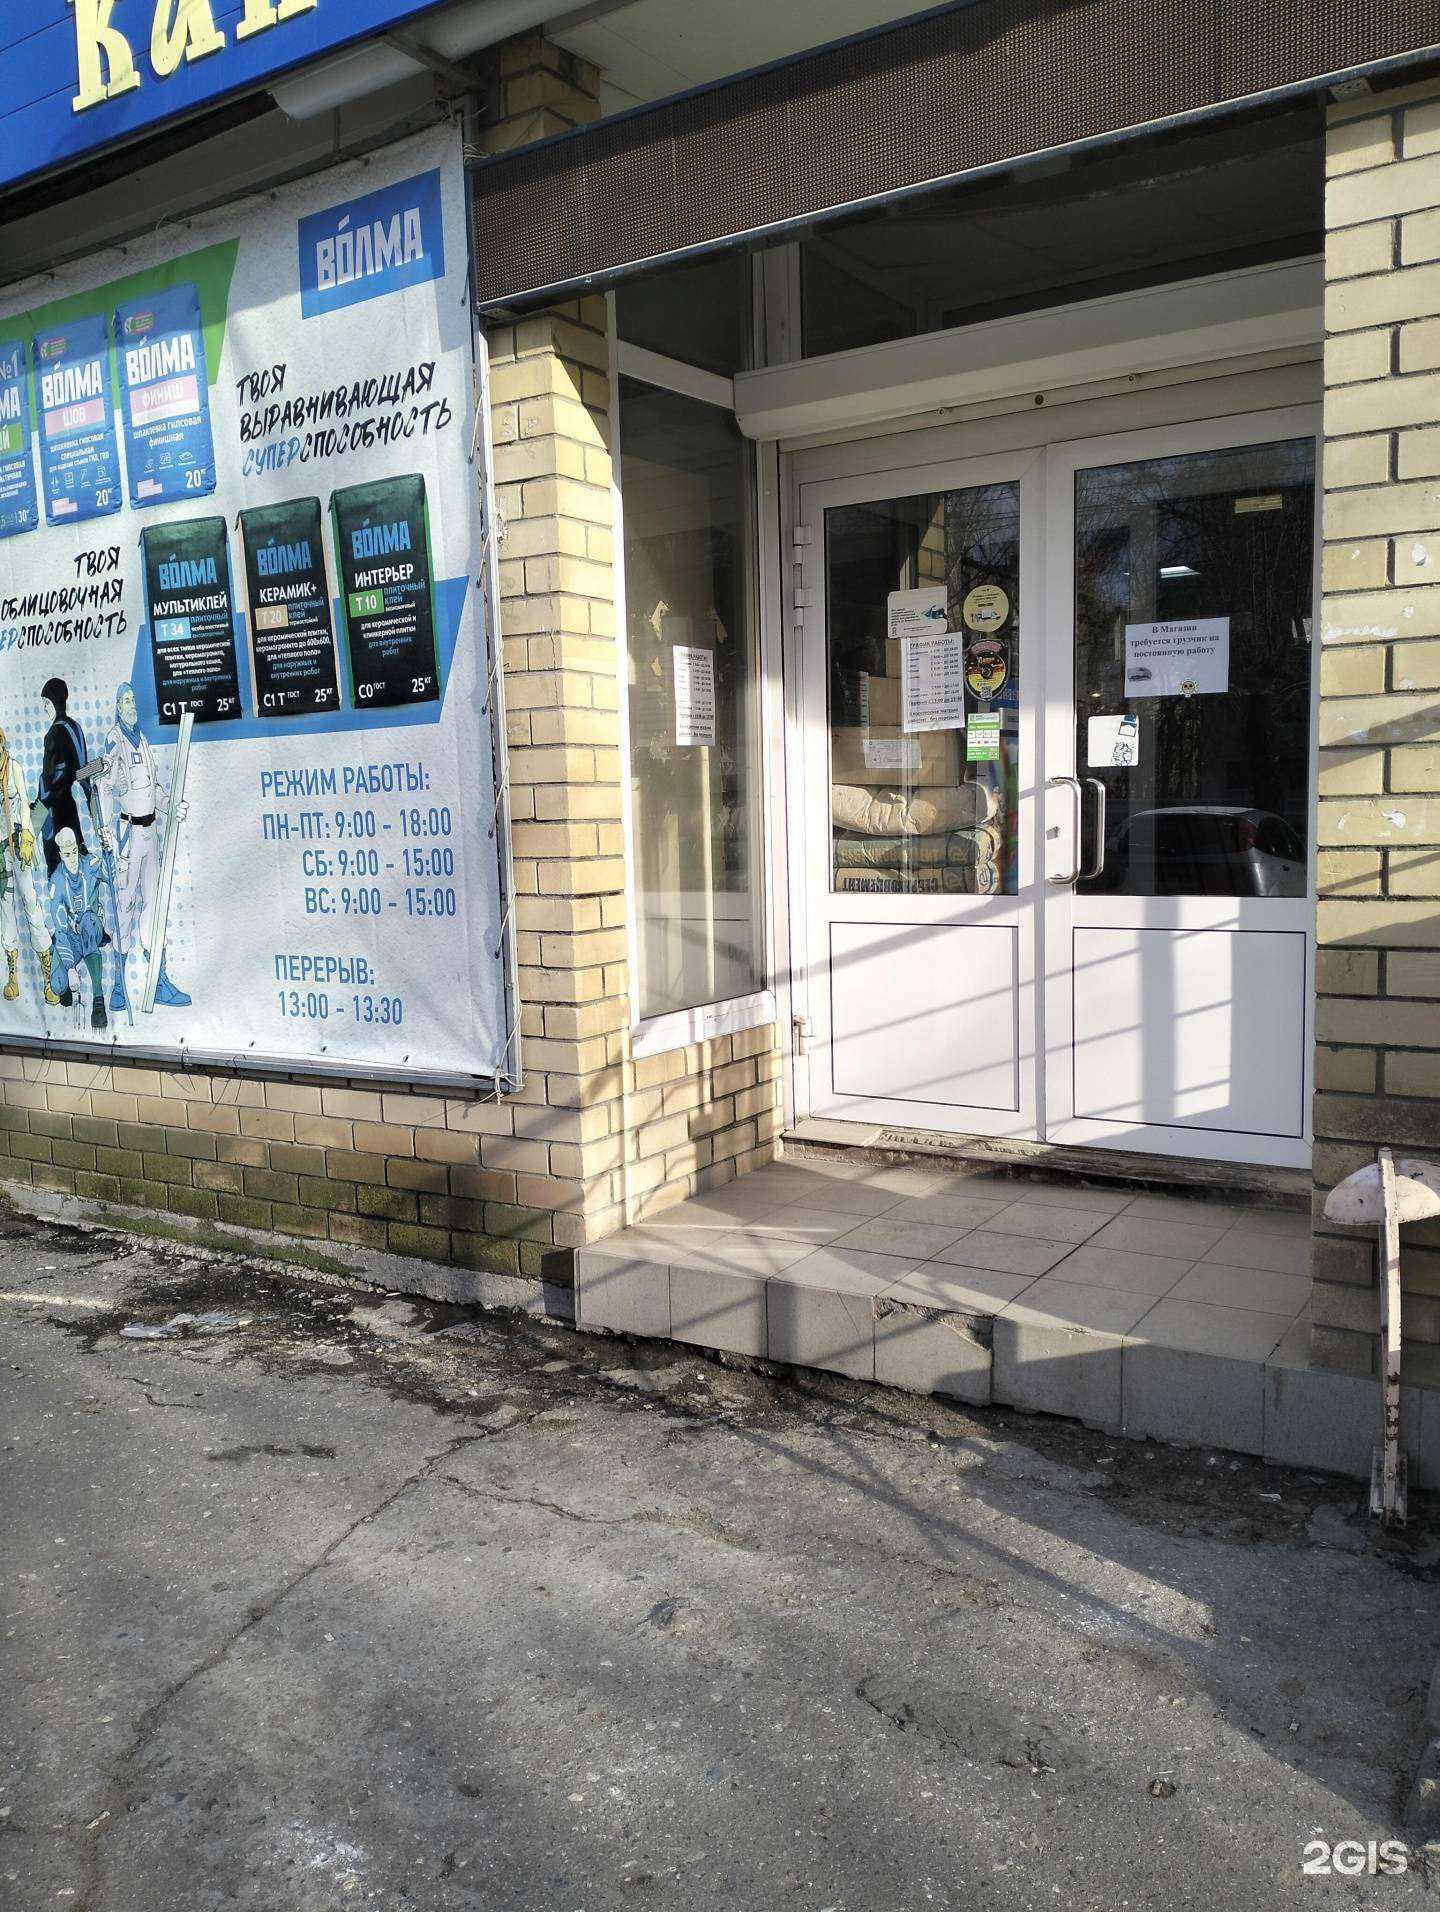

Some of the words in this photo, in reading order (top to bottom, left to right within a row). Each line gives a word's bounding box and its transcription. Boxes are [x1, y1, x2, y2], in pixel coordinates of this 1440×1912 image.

[142, 385, 184, 408] ФИНИШ
[236, 364, 286, 406] ТВОЯ
[240, 362, 436, 442] ВЫРАВНИВАЮЩАЯ
[62, 407, 85, 427] ШОВ
[167, 416, 202, 430] гипсовая
[243, 398, 451, 476] СУПЕРСПОСОБНОСТЬ
[74, 546, 121, 578] ТВОЯ
[355, 563, 413, 588] ИНТЕРЬЕР
[384, 579, 426, 595] плиточный
[1, 579, 123, 621] ОБЛИЦОВОЧНАЯ
[153, 591, 228, 616] МУЛЬТИКЛЕЙ
[260, 582, 317, 603] КЕРАМИК+
[288, 596, 325, 610] плиточный
[365, 595, 377, 609] 10
[385, 595, 403, 605] клей
[171, 622, 184, 635] 34
[270, 611, 281, 624] 20
[1160, 625, 1197, 633] Магазин
[1130, 638, 1170, 647] требуется
[1172, 636, 1207, 645] грузчик
[1134, 648, 1185, 658] постоянную
[1186, 646, 1216, 656] работу
[260, 767, 337, 798] РЕЖИМ
[343, 762, 430, 794] РАБОТЫ:
[263, 812, 331, 840] ПН-ПТ:
[335, 810, 375, 838] 9:00
[400, 807, 452, 837] 18:00
[302, 849, 333, 877] СБ:
[338, 849, 379, 877] 9:00
[403, 848, 454, 877] 15:00
[305, 887, 336, 914] ВС:
[341, 887, 381, 915] 9:00
[405, 887, 456, 916] 15:00
[274, 954, 375, 985] ПЕРЕРЫВ:
[278, 991, 329, 1019] 13:00
[353, 995, 403, 1025] 13:30
